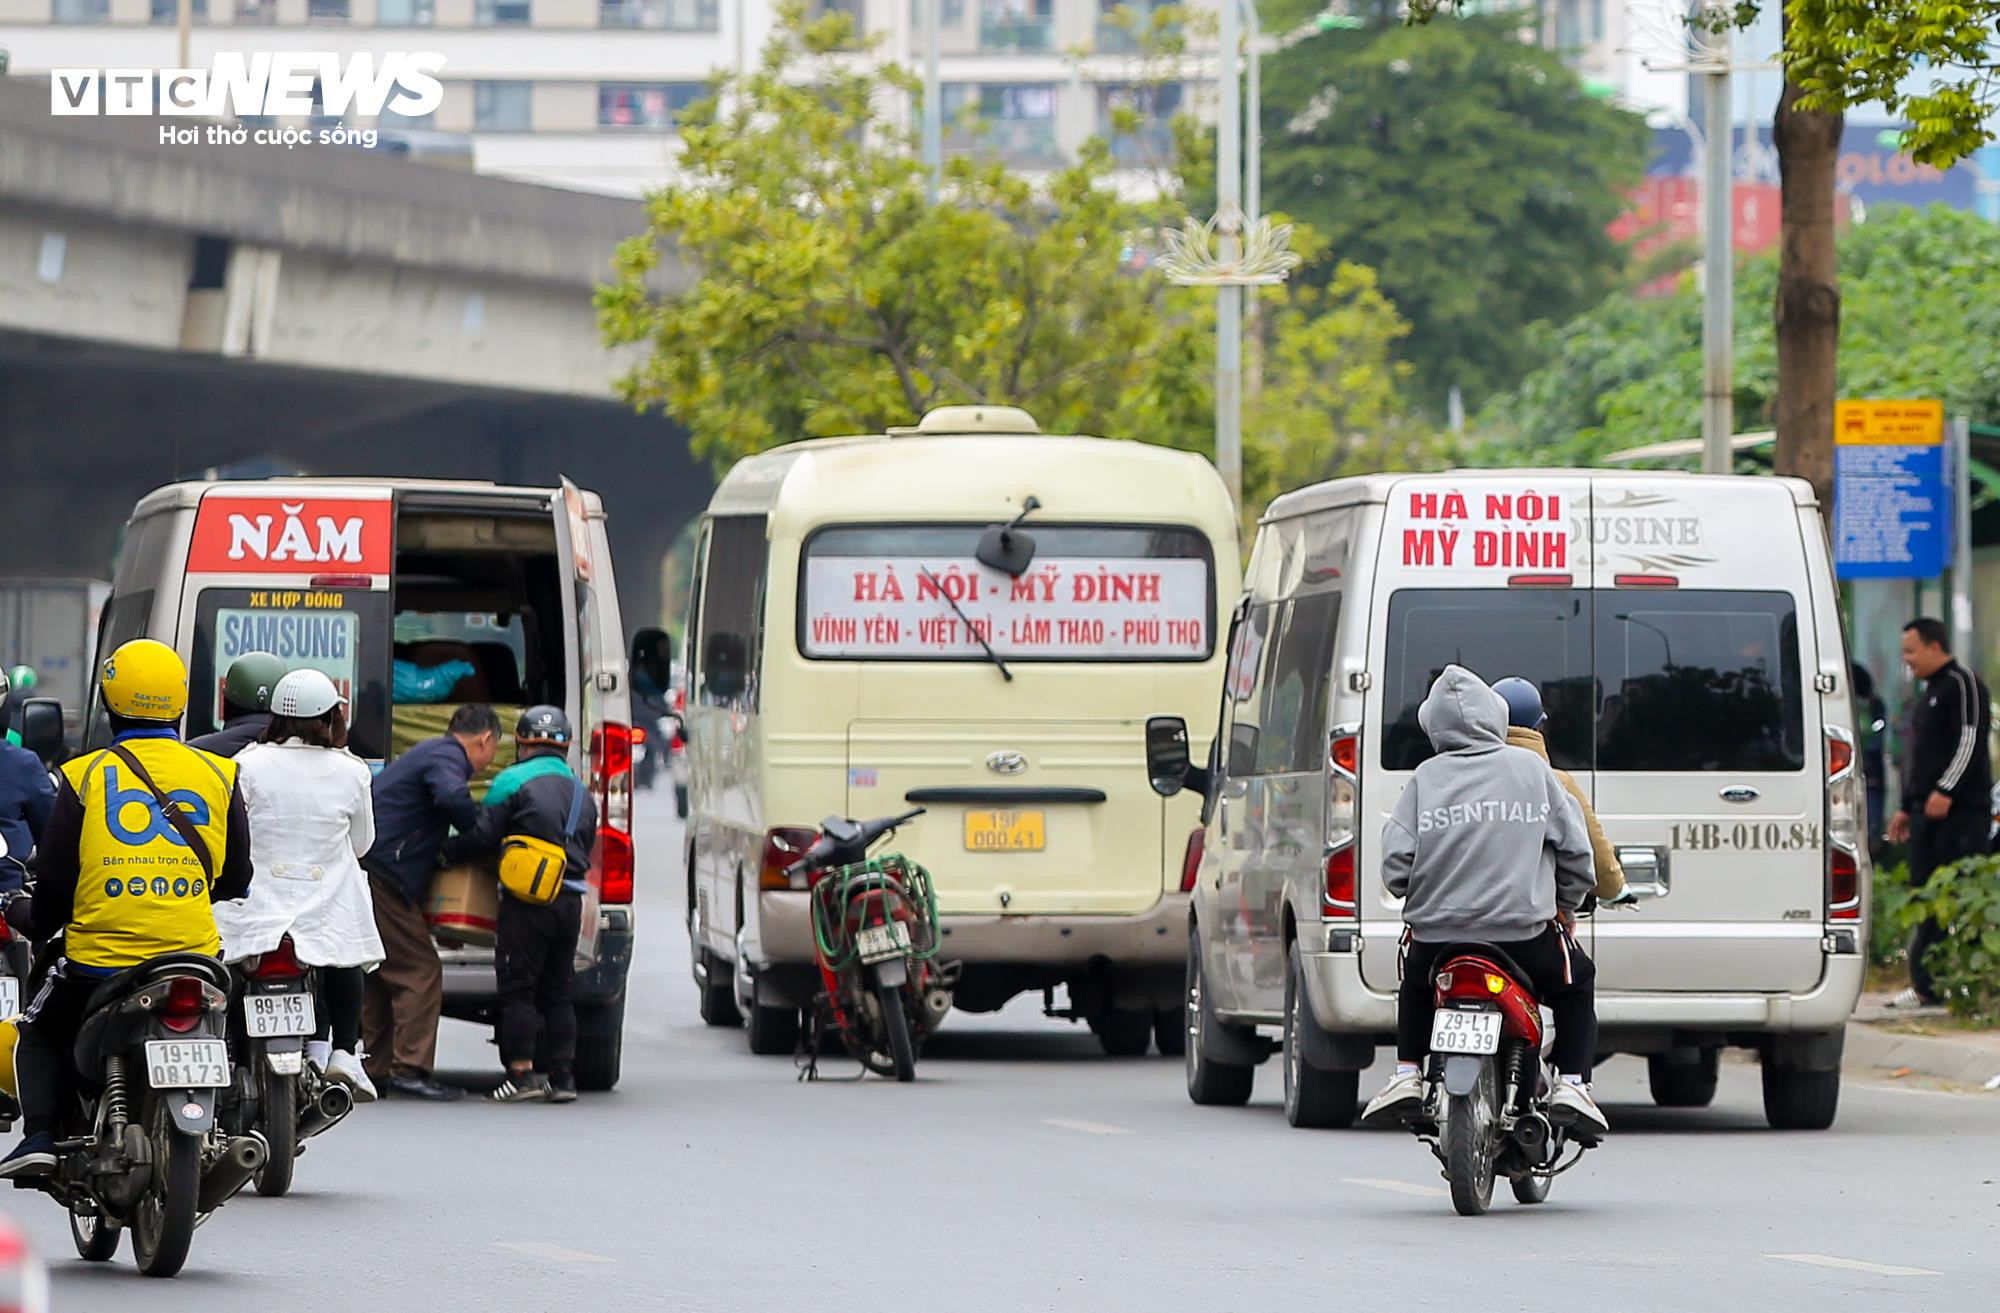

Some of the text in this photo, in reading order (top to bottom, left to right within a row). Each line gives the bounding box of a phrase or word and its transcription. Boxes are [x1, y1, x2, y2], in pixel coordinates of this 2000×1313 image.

[1409, 489, 1560, 526] HÀ NỘI
[227, 502, 364, 564] NĂM
[1402, 523, 1567, 569] MỸ ĐÌNH
[852, 564, 905, 602] HÀ
[1009, 564, 1060, 602] MỸ
[1071, 565, 1163, 602] ĐÌNH
[249, 591, 268, 608] XE
[271, 590, 301, 610] HỢP
[223, 614, 347, 659] SAMSUNG
[812, 612, 856, 645] VĨNH
[863, 613, 900, 645] YÊN
[918, 613, 957, 650] VIỆT
[965, 612, 993, 645] TRÌ
[1010, 613, 1052, 645] LÂM
[1058, 617, 1103, 645] THAO
[1122, 613, 1160, 645] PHÚ
[1165, 618, 1201, 652] THỌ
[103, 764, 211, 847] be
[1669, 822, 1821, 851] 14B-010.84
[127, 855, 155, 865] nhau
[157, 855, 179, 866] trọn
[254, 996, 303, 1015] 89-K5
[256, 1014, 306, 1034] 8712
[1444, 1013, 1490, 1032] 29-L1
[160, 1044, 213, 1063] 19-H1
[1436, 1031, 1494, 1051] 603.39
[153, 1064, 224, 1085] 081.73
